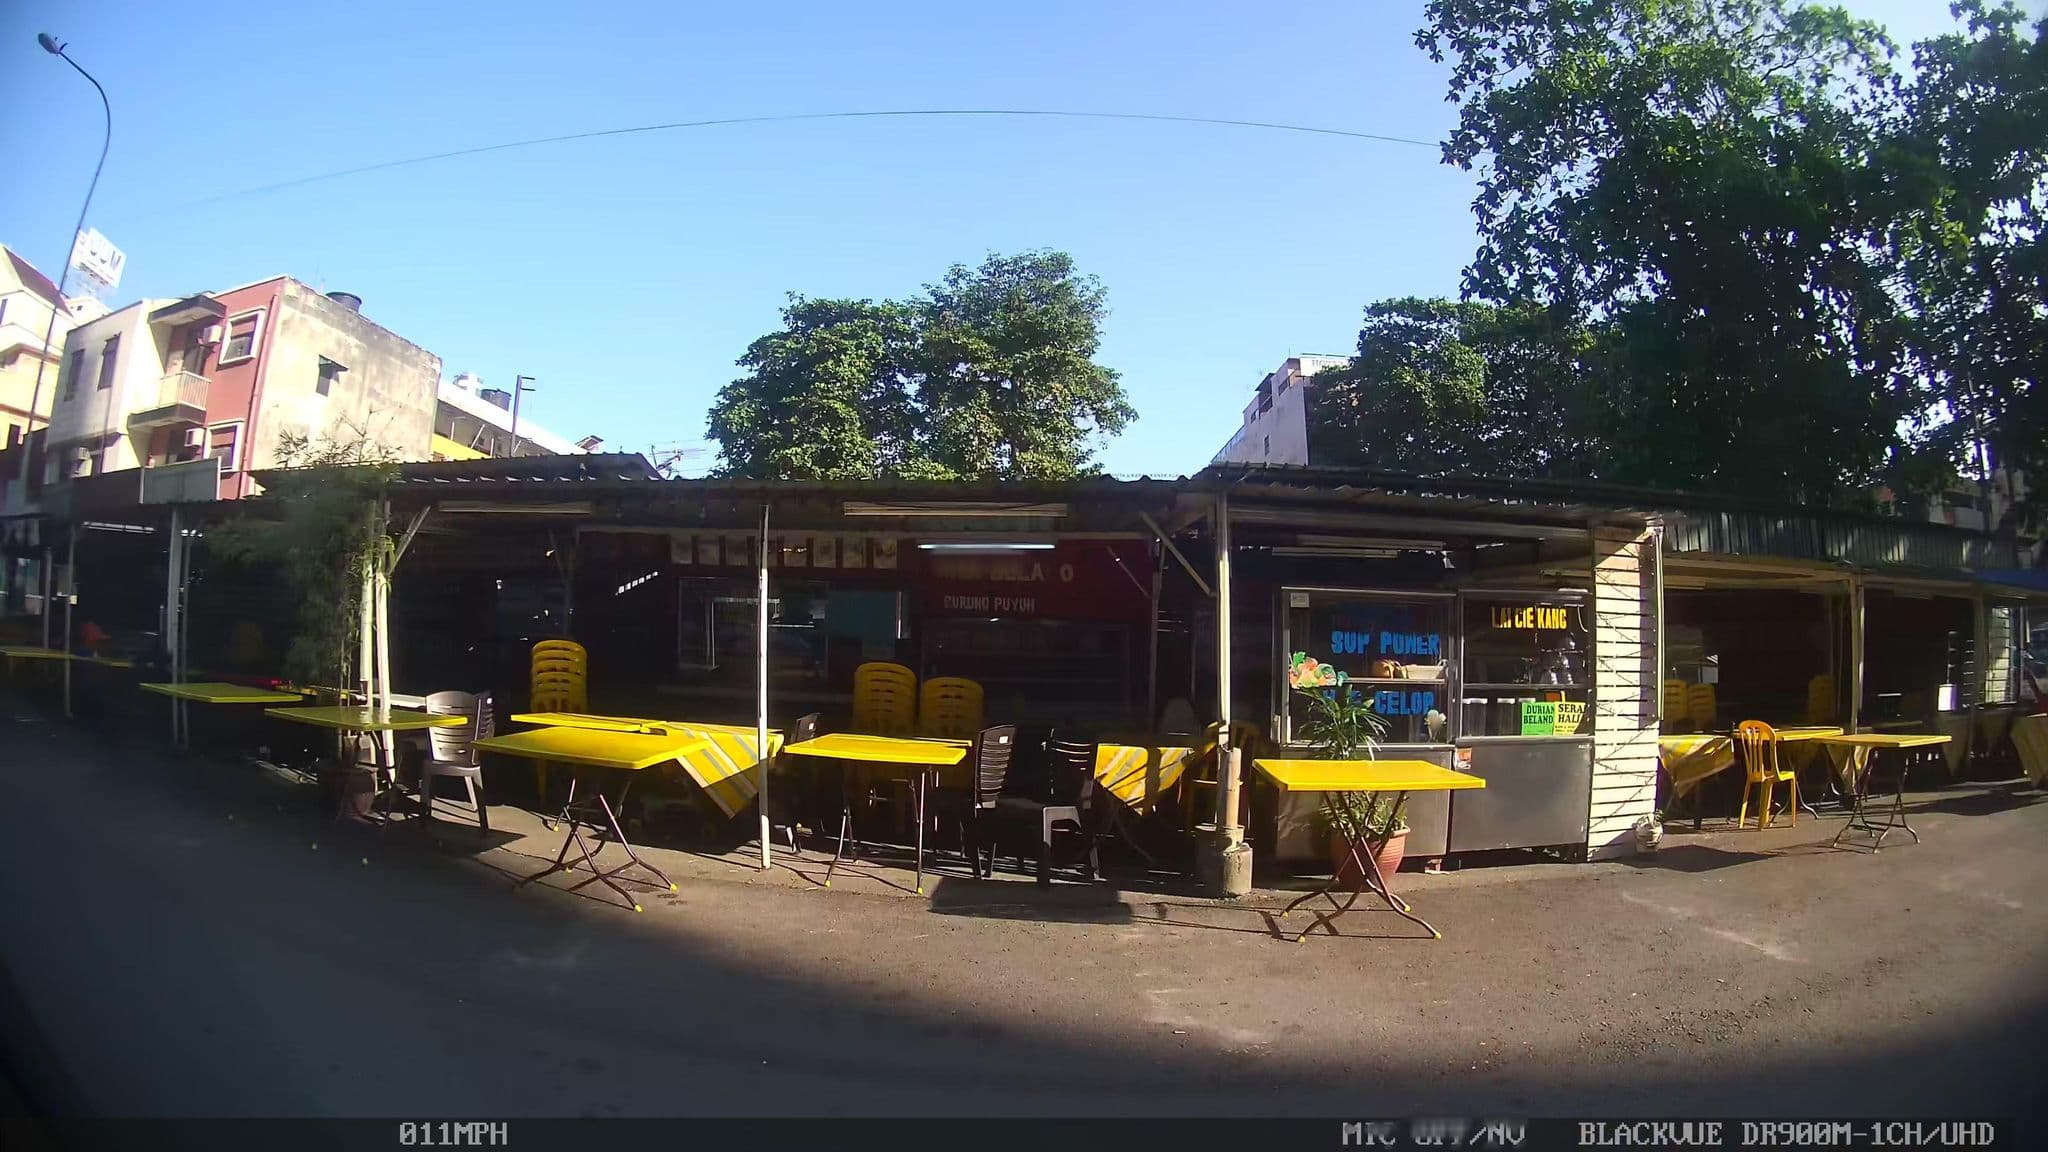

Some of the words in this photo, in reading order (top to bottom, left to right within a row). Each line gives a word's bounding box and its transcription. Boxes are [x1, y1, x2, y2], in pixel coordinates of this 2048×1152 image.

[1514, 606, 1535, 629] CIE
[1536, 606, 1568, 630] KANG
[1331, 630, 1370, 655] SUP
[1374, 689, 1435, 715] CELOP
